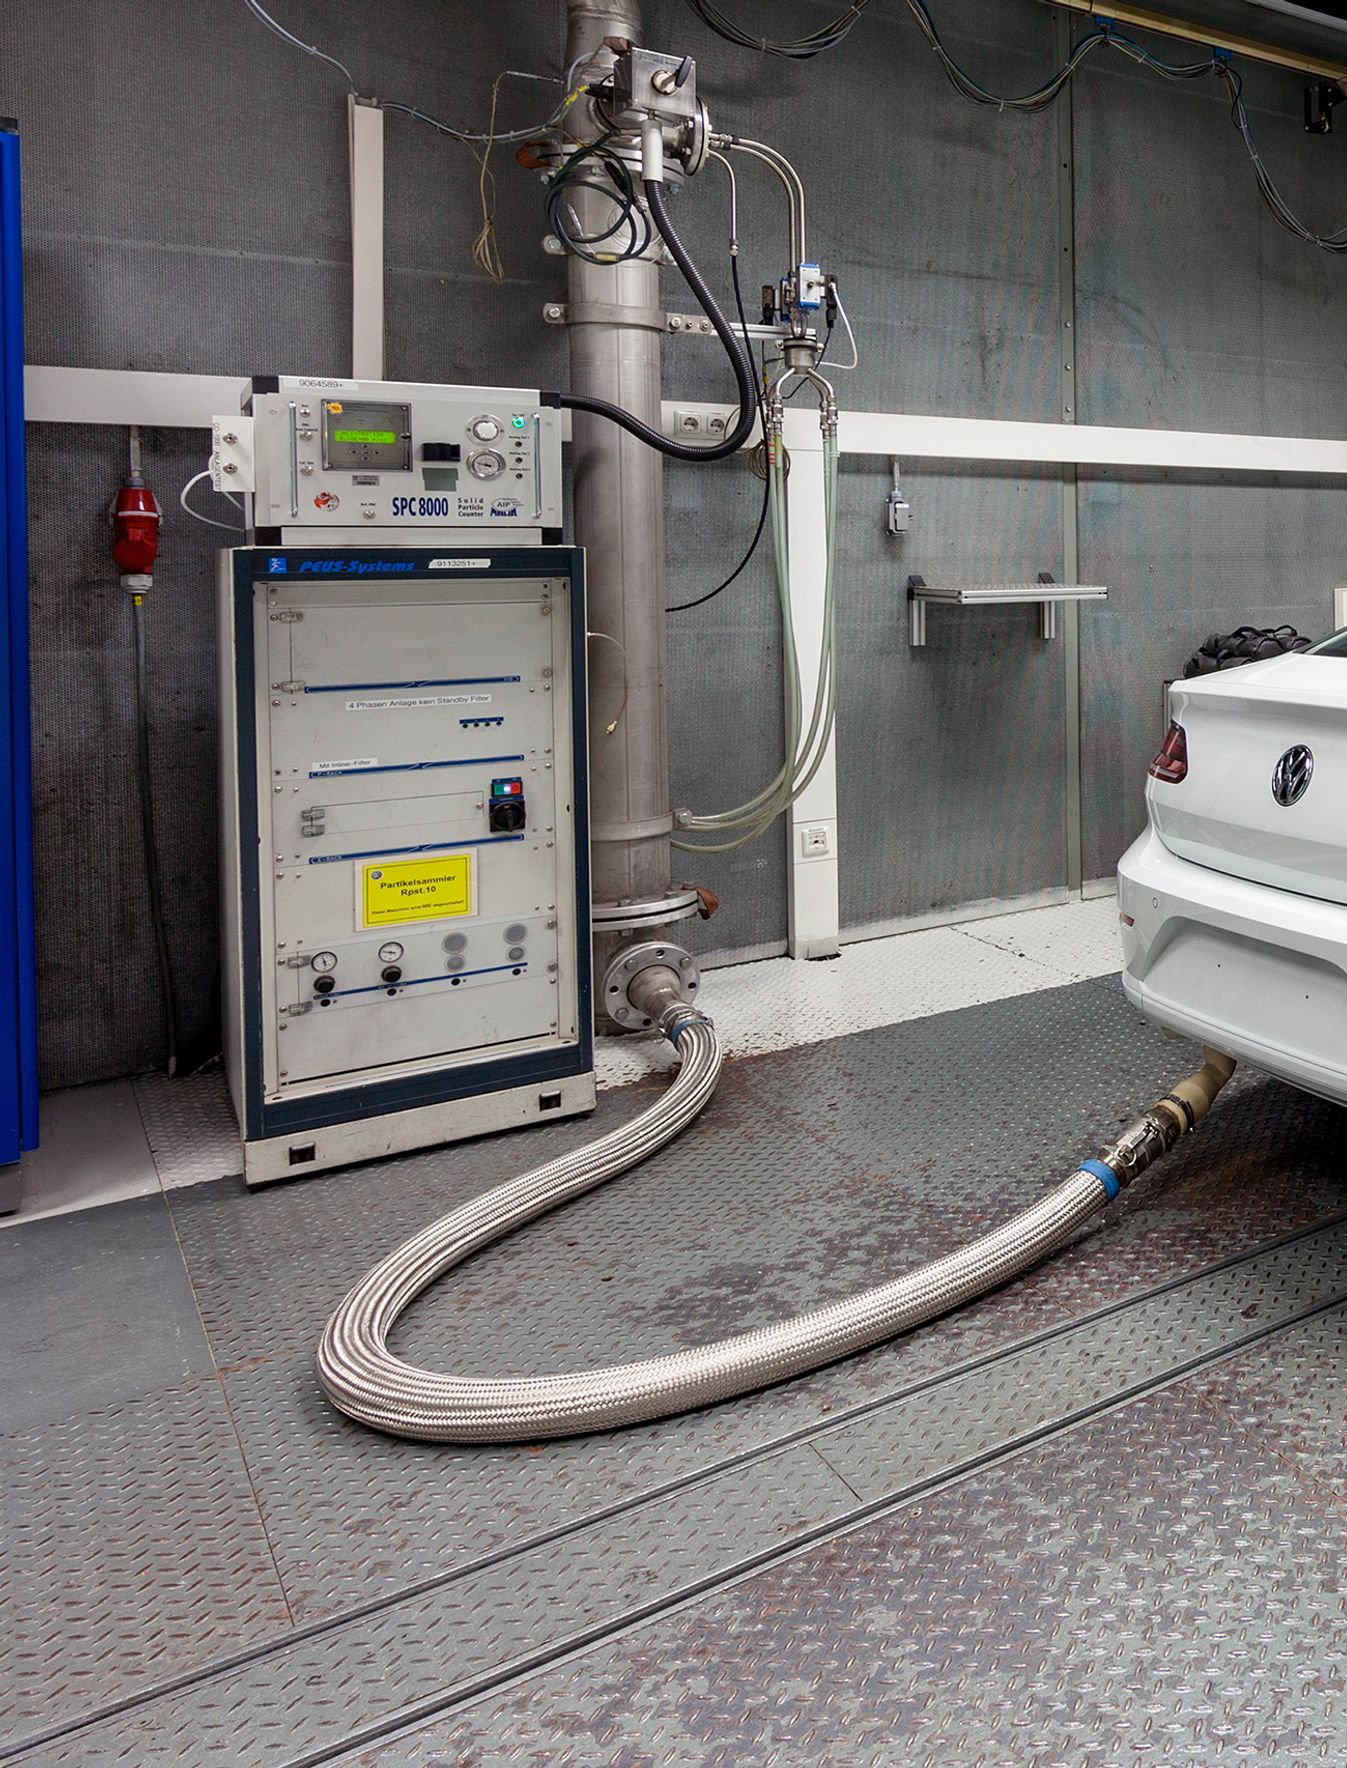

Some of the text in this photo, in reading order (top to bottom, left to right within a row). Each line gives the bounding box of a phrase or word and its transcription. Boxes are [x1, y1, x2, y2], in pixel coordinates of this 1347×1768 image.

[392, 496, 449, 516] SPC 8000
[300, 560, 416, 574] PEUS-Systems
[436, 696, 468, 704] Standby
[380, 875, 456, 889] Partikelsammler
